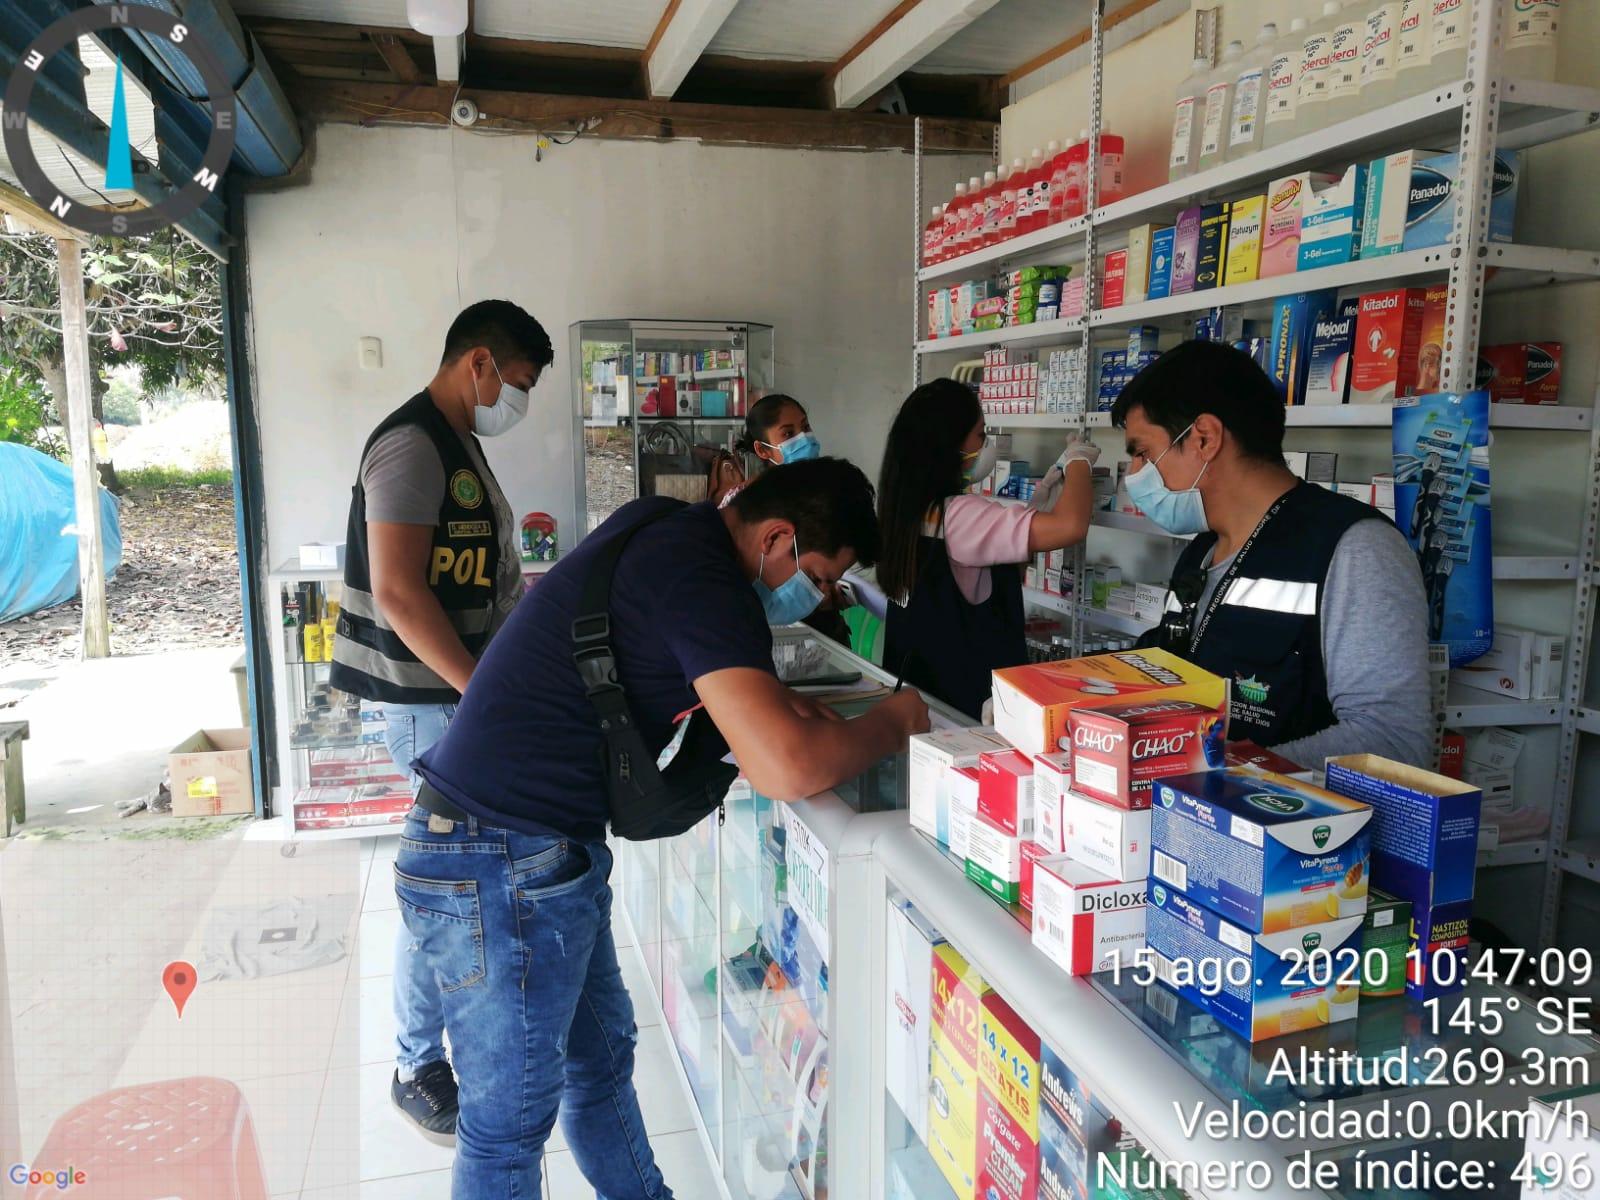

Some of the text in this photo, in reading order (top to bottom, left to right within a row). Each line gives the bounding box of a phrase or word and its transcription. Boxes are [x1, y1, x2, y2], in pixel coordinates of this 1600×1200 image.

[1410, 181, 1449, 201] Panadol
[1231, 223, 1259, 237] Flatuzym
[1269, 224, 1275, 236] 5
[1303, 248, 1322, 260] 3-Gel
[1362, 296, 1399, 312] kitadol
[1408, 298, 1424, 308] kita
[1315, 320, 1350, 340] Mejoral
[1275, 304, 1292, 383] APRONAX
[1527, 360, 1553, 370] Panadol
[430, 546, 491, 587] POL
[1210, 578, 1231, 613] REGIONAL
[1229, 565, 1239, 576] DE
[1237, 540, 1253, 562] SALUD
[1230, 701, 1276, 717] CCION REGIONAL
[1242, 710, 1260, 719] SALUD
[1244, 715, 1254, 723] DE
[1256, 719, 1270, 728] DIOS
[1074, 727, 1117, 752] CHAO
[1132, 734, 1189, 759] CHAO
[1313, 831, 1331, 840] VICK
[1300, 856, 1339, 868] VitaPyrena
[1432, 920, 1468, 934] NASTIZOL
[1303, 938, 1321, 947] VICK
[1431, 930, 1467, 941] COMPOSITUM
[983, 1023, 996, 1051] 14
[1012, 1056, 1030, 1089] 12
[981, 1051, 1030, 1116] GRATIS
[1042, 1062, 1084, 1126] Andrews
[987, 1107, 1022, 1151] Colgate
